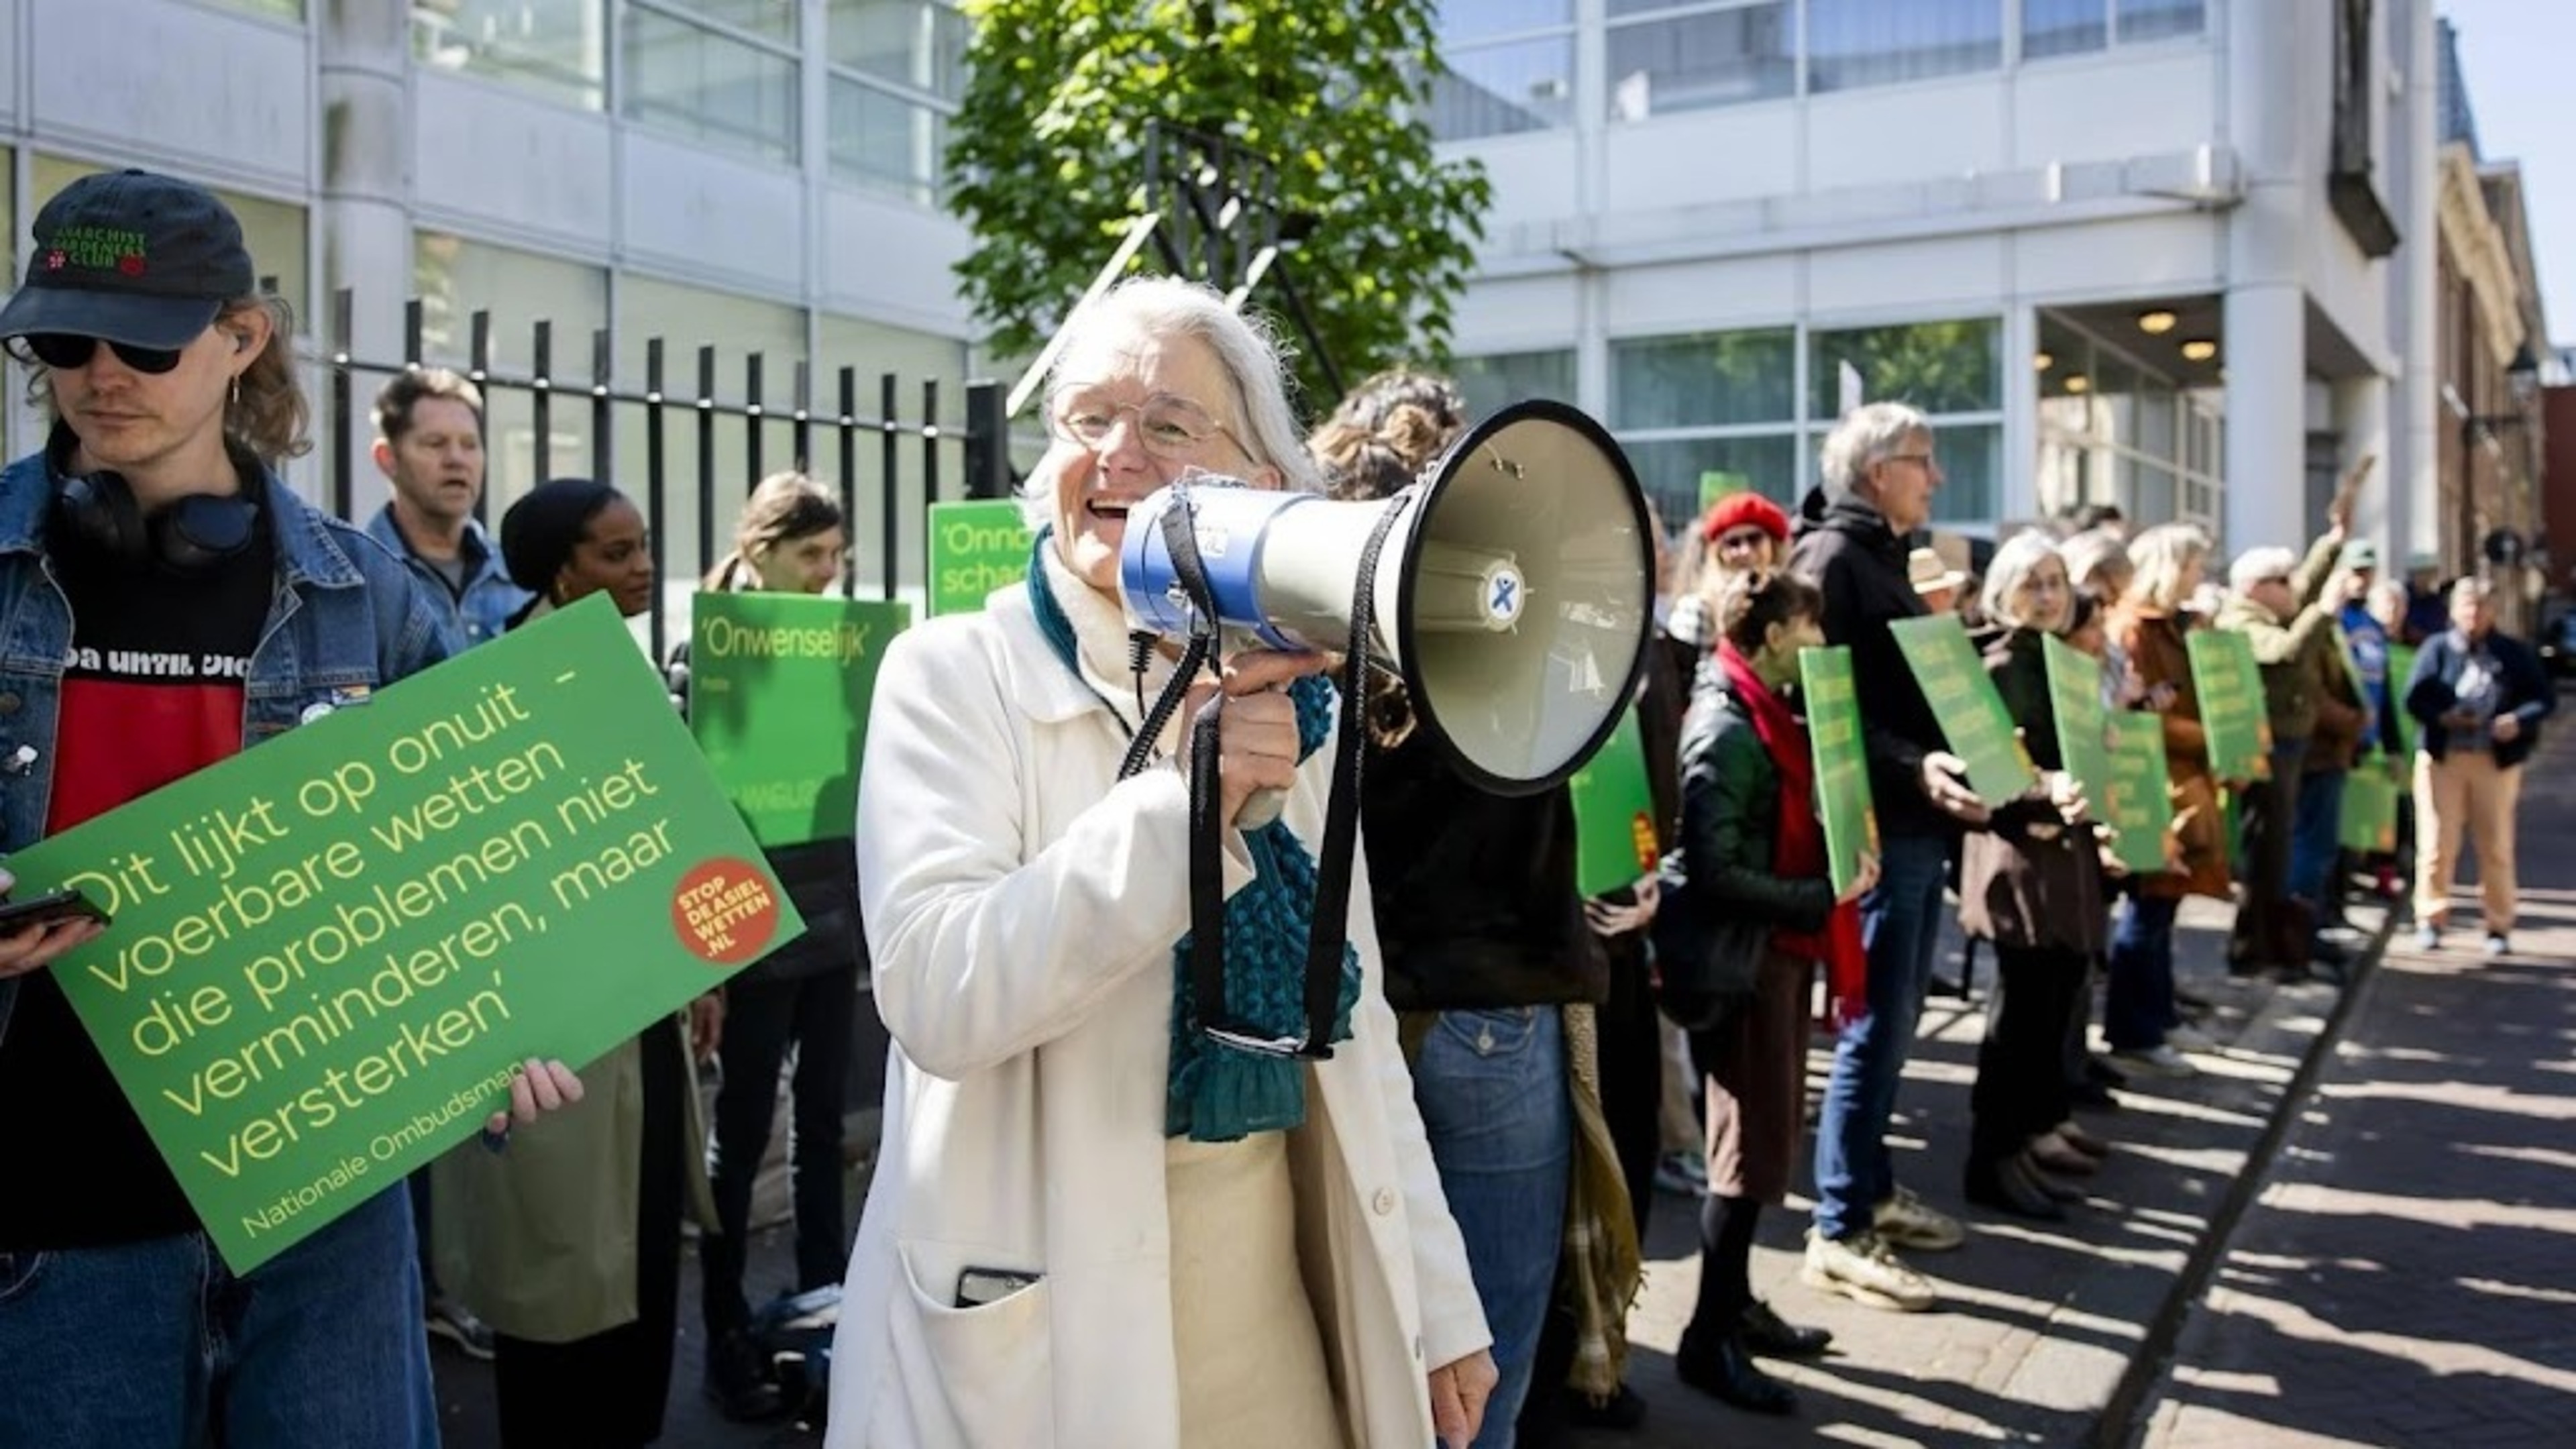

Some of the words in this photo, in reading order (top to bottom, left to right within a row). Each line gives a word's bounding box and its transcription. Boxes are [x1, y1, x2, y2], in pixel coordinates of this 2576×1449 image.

[70, 251, 115, 268] CLUB
[702, 616, 870, 667] 'Onwenselijk'
[170, 796, 290, 879] lijkt
[299, 761, 377, 816] op
[389, 683, 531, 774] onuit
[88, 841, 366, 992] voerbare
[370, 741, 566, 853] wetten
[678, 875, 726, 910] STOP
[132, 986, 233, 1056] die
[244, 820, 552, 1012] problemen
[556, 757, 659, 835] niet
[686, 903, 714, 926] DE
[712, 878, 763, 914] ASIEL
[694, 892, 771, 941] WETTEN
[162, 902, 547, 1116] verminderen,
[550, 818, 673, 910] maar
[707, 932, 737, 958] .NL
[200, 969, 511, 1177] versterken'
[241, 1155, 368, 1239] Nationale
